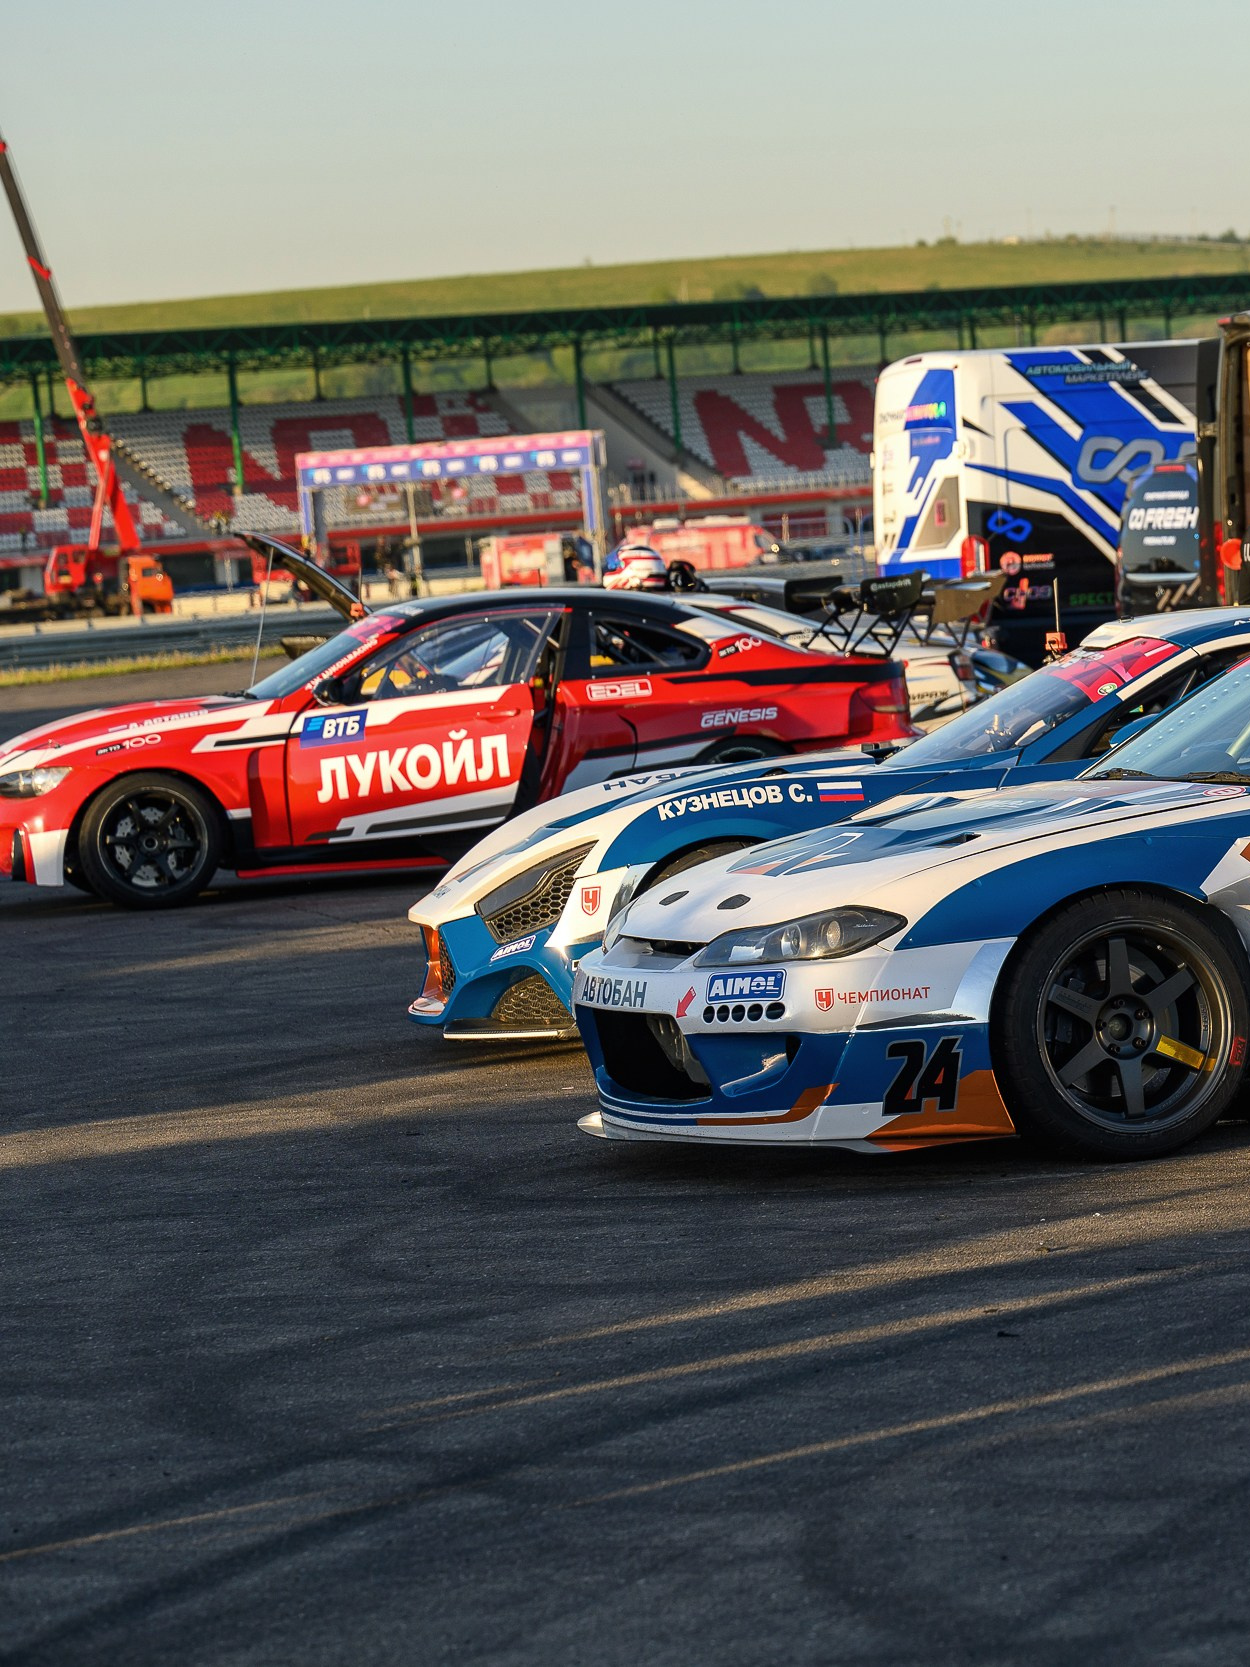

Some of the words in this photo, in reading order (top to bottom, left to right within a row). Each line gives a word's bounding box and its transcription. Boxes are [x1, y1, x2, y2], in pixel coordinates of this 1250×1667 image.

[591, 681, 649, 698] EDEL
[322, 715, 361, 739] ВТБ
[701, 707, 778, 729] GENESIS
[122, 733, 161, 750] 100
[316, 728, 511, 803] ЛУКОЙЛ
[657, 785, 783, 821] КУЗНЕЦОВ
[788, 783, 814, 803] С.
[494, 939, 532, 958] AIMOL
[581, 975, 648, 1008] АВТОБАН
[709, 976, 779, 998] AIMOL
[838, 986, 931, 1004] ЧЕМПИОНАТ
[882, 1034, 964, 1117] 24
